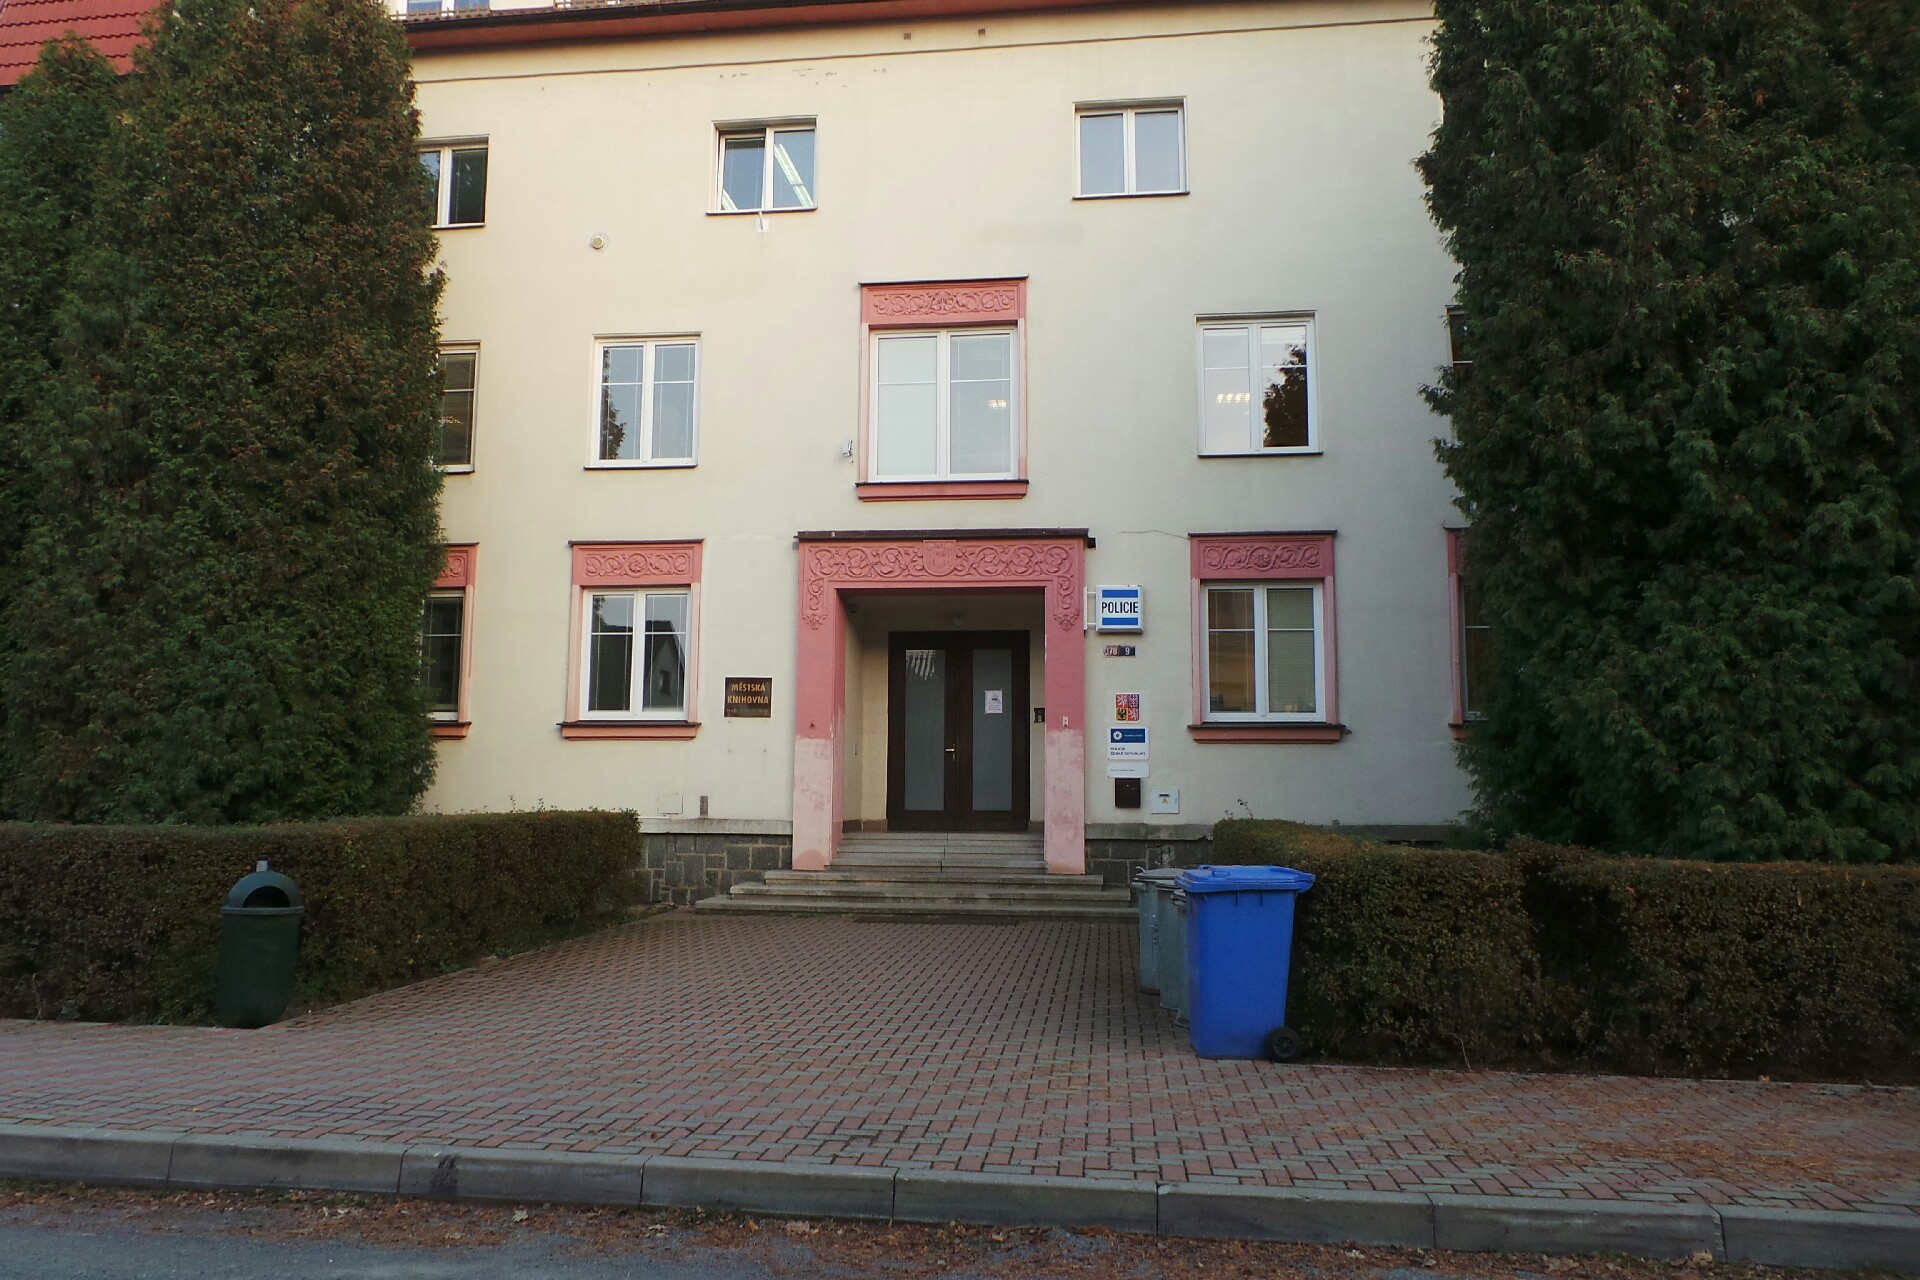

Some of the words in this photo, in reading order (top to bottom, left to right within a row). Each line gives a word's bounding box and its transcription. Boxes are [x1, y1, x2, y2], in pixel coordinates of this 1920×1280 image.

[1101, 602, 1138, 613] POLICIE
[1124, 647, 1130, 656] 9
[731, 681, 766, 692] MĚSTSKÁ
[727, 695, 769, 704] KNIHOVNA
